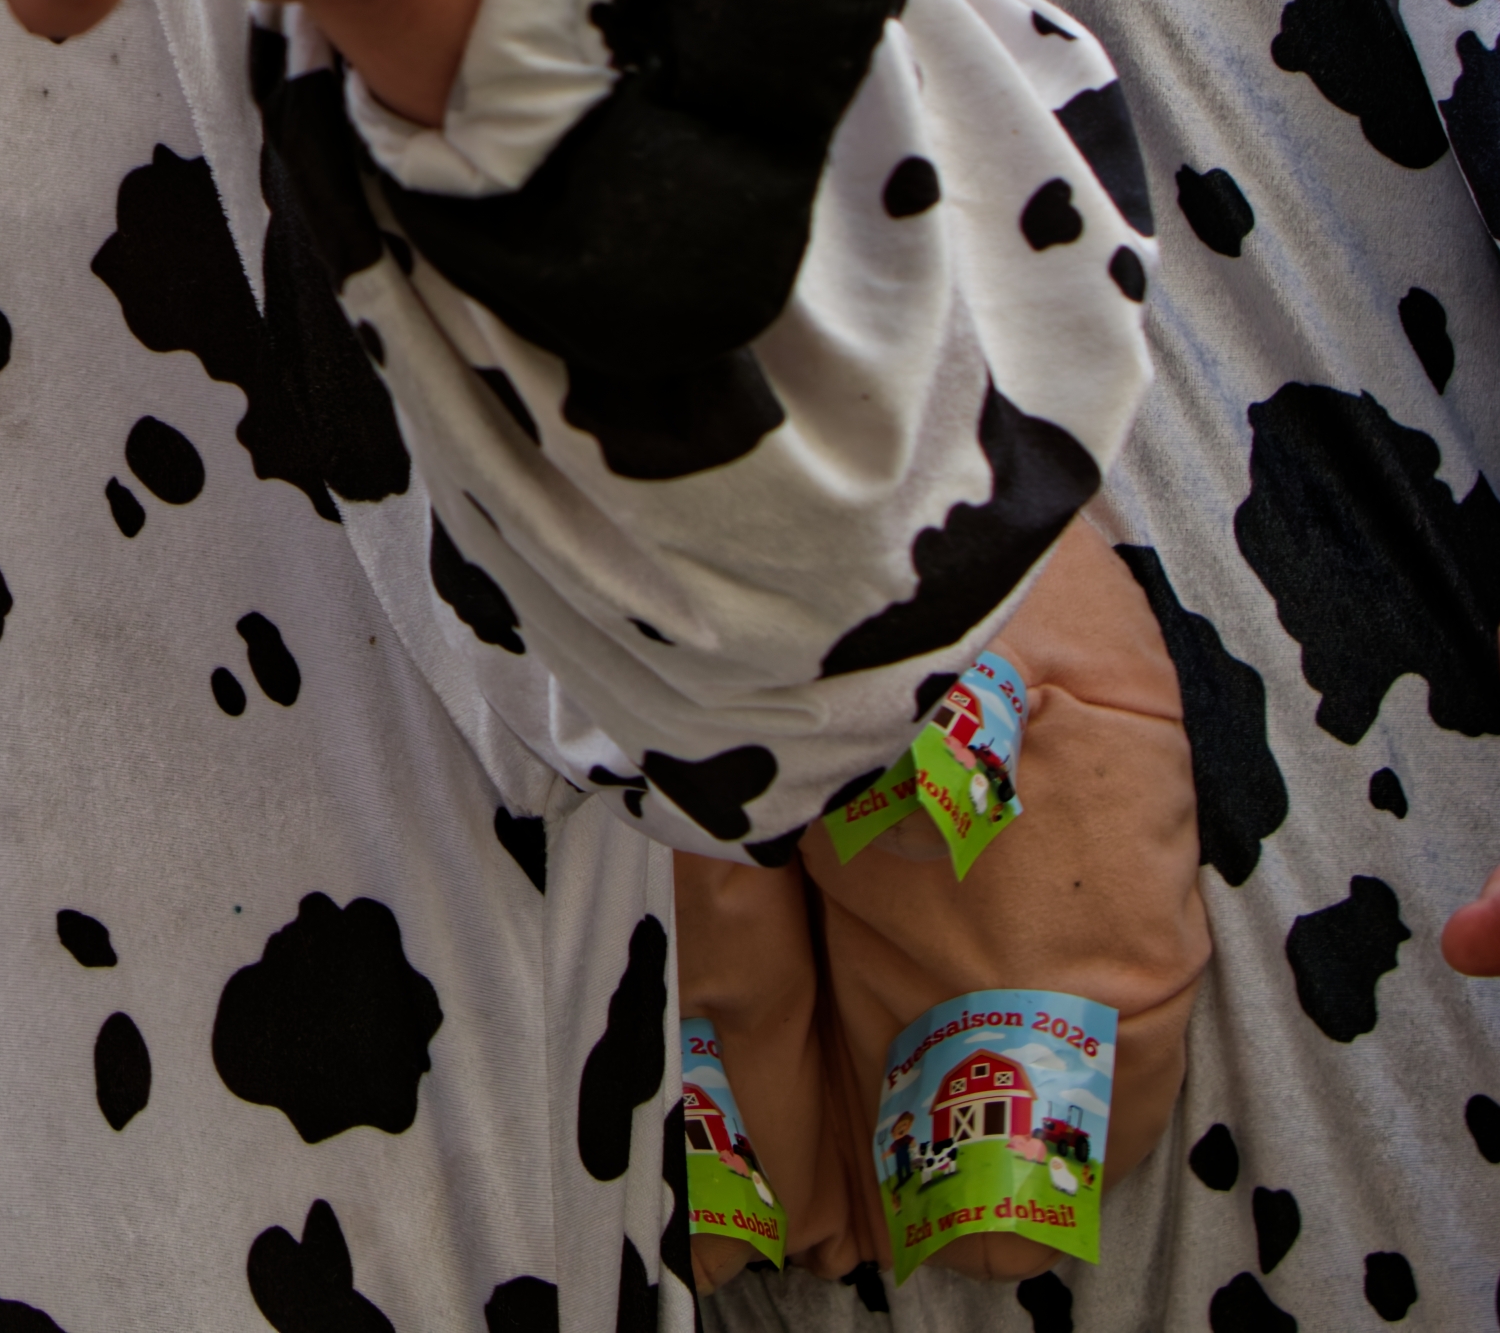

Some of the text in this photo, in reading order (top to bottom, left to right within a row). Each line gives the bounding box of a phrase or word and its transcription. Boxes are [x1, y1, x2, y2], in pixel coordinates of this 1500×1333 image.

[845, 787, 890, 822] Ech
[887, 1010, 1100, 1091] Fuessaison 2026
[732, 1208, 780, 1241] dobäi!
[904, 1196, 1077, 1248] Ech war dobäi!
